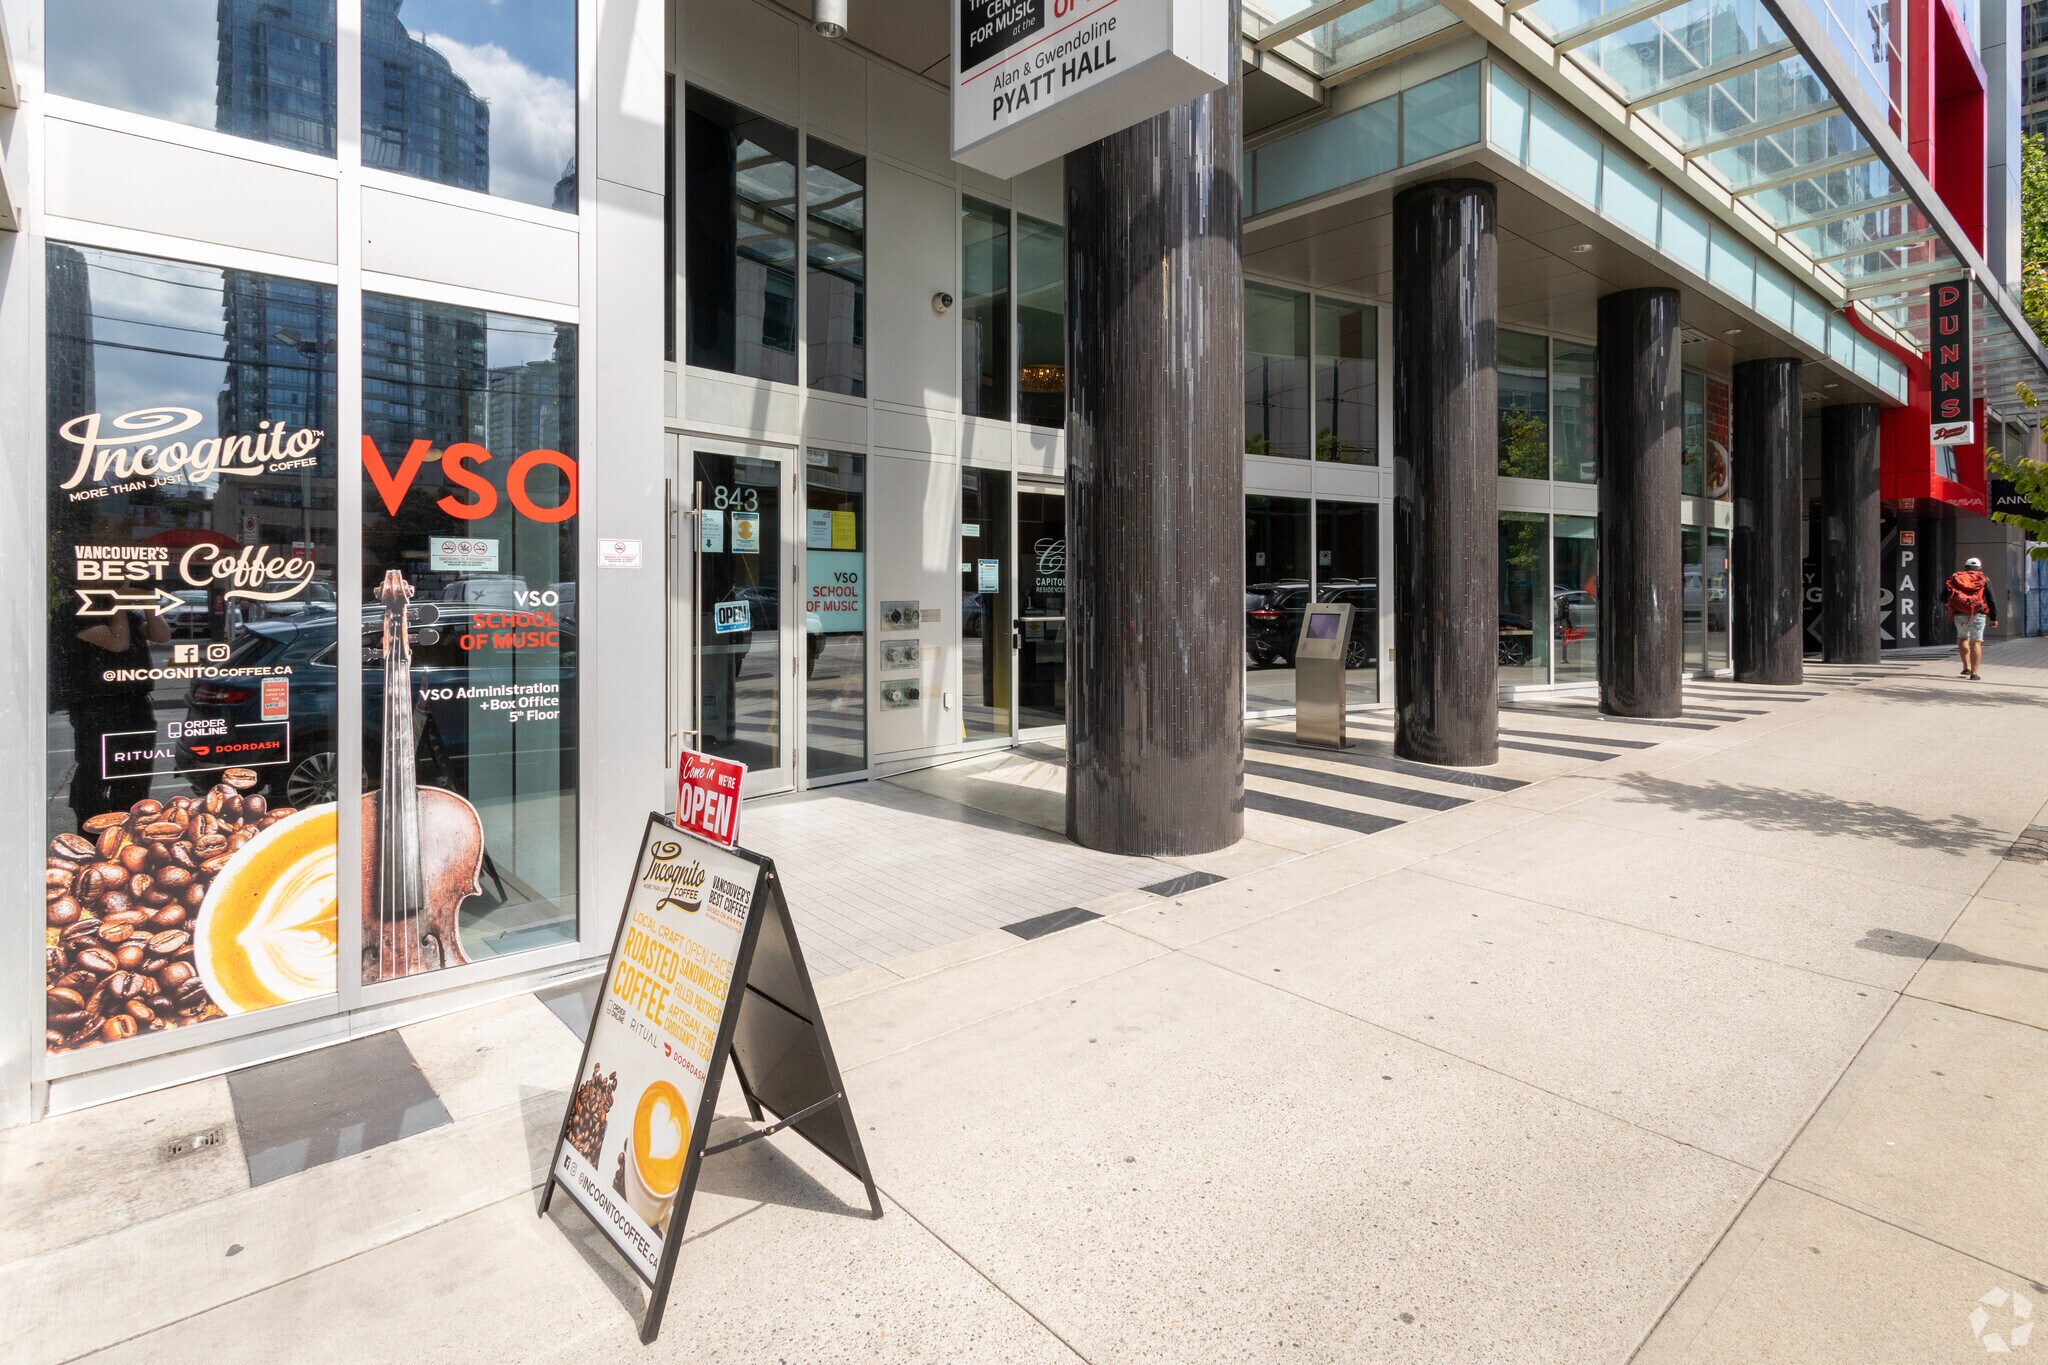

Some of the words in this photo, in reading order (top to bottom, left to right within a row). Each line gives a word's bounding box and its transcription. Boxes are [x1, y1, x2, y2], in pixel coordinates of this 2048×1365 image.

[970, 22, 993, 47] FOR
[996, 0, 1035, 33] MUSIC
[1013, 24, 1021, 36] at
[1022, 17, 1035, 30] the
[993, 66, 1019, 92] Alan
[1023, 61, 1031, 76] &
[1035, 17, 1116, 69] Gwendoline
[993, 68, 1055, 121] PYATT
[1062, 39, 1116, 87] HALL
[1939, 286, 1961, 418] DUNNS
[59, 407, 321, 489] Incognito
[69, 486, 109, 502] MORE
[111, 481, 147, 493] THAN
[148, 474, 183, 488] JUST
[269, 457, 318, 473] COFFEE
[362, 434, 579, 523] VSO
[714, 485, 759, 512] 843
[74, 545, 168, 560] VANCOUVER'S
[77, 561, 169, 581] BEST
[179, 543, 315, 600] Coffee
[834, 572, 858, 583] VSO
[513, 590, 559, 607] VSO
[806, 601, 820, 612] OF
[823, 600, 858, 611] MUSIC
[812, 586, 858, 597] SCHOOL
[1899, 551, 1917, 638] PARK
[472, 612, 559, 629] SCHOOL
[718, 605, 747, 625] OPEN
[459, 634, 488, 651] OF
[493, 632, 559, 649] MUSIC
[103, 666, 293, 682] @INCOGNITOCOFFEE.CA
[420, 689, 453, 701] VSO
[456, 683, 559, 700] Administration
[518, 697, 559, 708] Office
[184, 719, 226, 729] ORDER
[509, 710, 524, 722] 5th
[526, 709, 560, 721] Floor
[184, 727, 228, 737] ONLINE
[114, 749, 175, 762] RITUAL
[215, 741, 280, 753] DOORDASH
[683, 756, 705, 780] Come
[706, 762, 716, 780] in
[718, 774, 736, 789] WE'RE
[680, 782, 733, 837] OPEN
[643, 841, 706, 912] Incognito
[712, 875, 751, 904] VANCOUVER'S
[674, 887, 699, 900] COFFEE
[709, 890, 724, 908] BEST
[723, 897, 746, 920] COFFEE
[632, 909, 657, 933] LOCAL
[657, 924, 685, 946] CRAFT
[623, 926, 680, 985] ROASTED
[685, 939, 709, 963] OPEN
[709, 953, 734, 979] FACE
[613, 960, 670, 1027] COFFEE
[679, 957, 728, 1001] SANDWICHES
[611, 1010, 625, 1024] ONLINE
[612, 1003, 626, 1015] ORDER
[674, 982, 698, 1006] FILLED
[694, 995, 722, 1025] PASTRIES
[629, 1018, 657, 1049] RITUAL
[668, 1003, 701, 1034] ARTISAN
[701, 1025, 717, 1045] FINE
[697, 1040, 713, 1062] TEAS
[673, 1052, 706, 1083] DOORDASH
[578, 1172, 658, 1270] @INCOGNITOCOFFEE.CA
